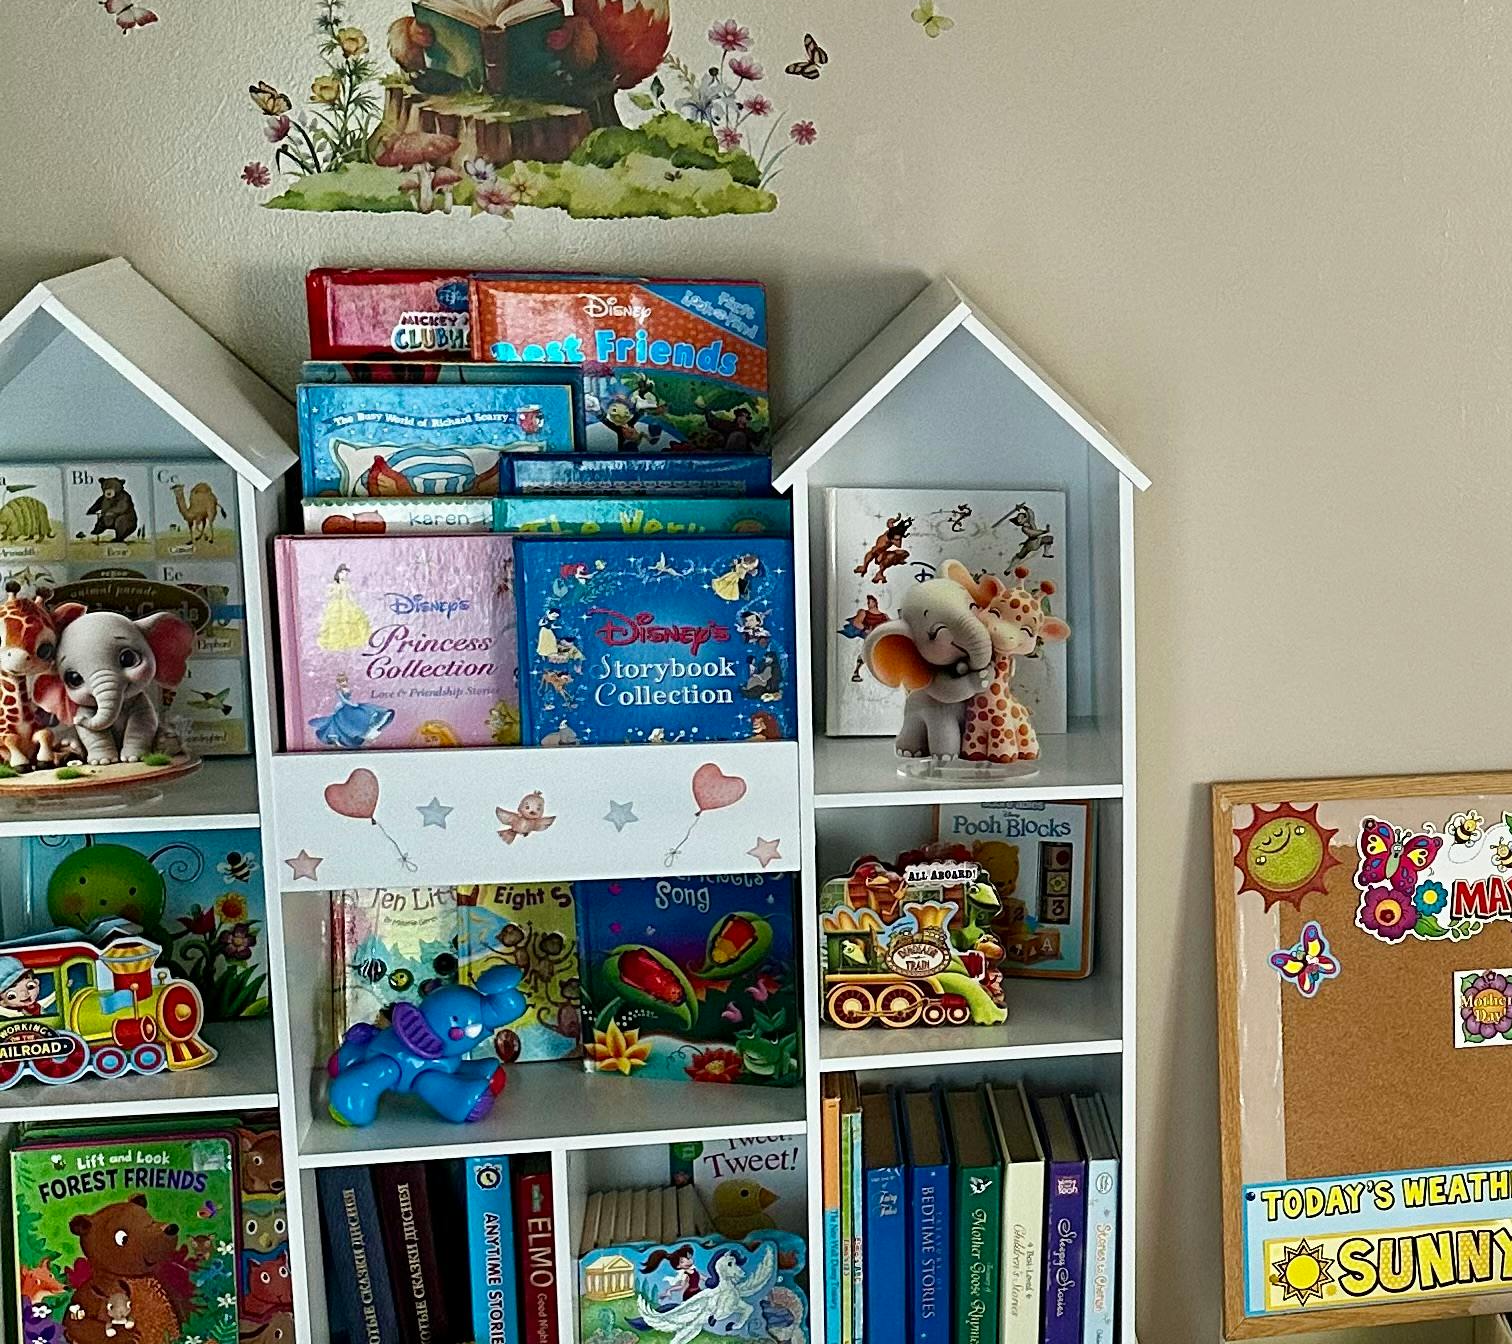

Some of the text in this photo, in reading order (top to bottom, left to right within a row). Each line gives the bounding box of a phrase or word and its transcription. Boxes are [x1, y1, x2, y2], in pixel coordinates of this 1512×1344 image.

[401, 315, 458, 326] MICKEY
[577, 293, 652, 325] Disney
[594, 329, 738, 377] Friends
[333, 415, 354, 427] The
[357, 412, 382, 423] Busy
[385, 413, 414, 427] World
[417, 418, 428, 428] of
[432, 415, 472, 428] Richard
[72, 470, 94, 485] Bb
[157, 470, 178, 484] Cc
[409, 512, 469, 526] karen
[163, 567, 183, 581] Ee
[70, 583, 157, 598] animal parade
[384, 593, 470, 618] Disney's
[362, 624, 494, 657] Princess
[587, 608, 731, 656] Disney's
[367, 656, 496, 680] Collection
[591, 654, 737, 683] Storybook
[371, 689, 395, 699] Love
[409, 686, 463, 699] Friendship
[595, 682, 734, 707] Collection
[953, 816, 1071, 837] Pooh Blocks
[908, 869, 978, 882] ALL ABOARD!
[371, 887, 406, 912] Ten
[493, 887, 545, 911] Eight
[655, 881, 710, 913] Song
[1052, 899, 1065, 916] 3
[1041, 938, 1053, 952] A
[906, 960, 930, 972] TRAIN
[0, 1042, 61, 1059] AILROAD
[76, 1150, 170, 1170] Lift and Look
[704, 1147, 799, 1178] Tweet!
[38, 1168, 208, 1204] FOREST FRIENDS
[397, 1183, 418, 1242] ДИСНЕЯ
[1261, 1179, 1396, 1221] TODAY'S
[971, 1208, 987, 1260] Mother
[1096, 1224, 1112, 1262] Stories
[484, 1212, 502, 1285] ANYTIME
[527, 1217, 554, 1288] ELMO
[921, 1186, 935, 1319] BEDTIME STORIES
[353, 1247, 373, 1304] СКАЗКИ
[406, 1243, 426, 1299] СКАЗКИ
[970, 1262, 986, 1296] Goose
[1011, 1224, 1025, 1317] Children's Stories
[1053, 1218, 1077, 1317] Sleepy Stories
[537, 1293, 548, 1319] Good
[537, 1320, 549, 1344] Night
